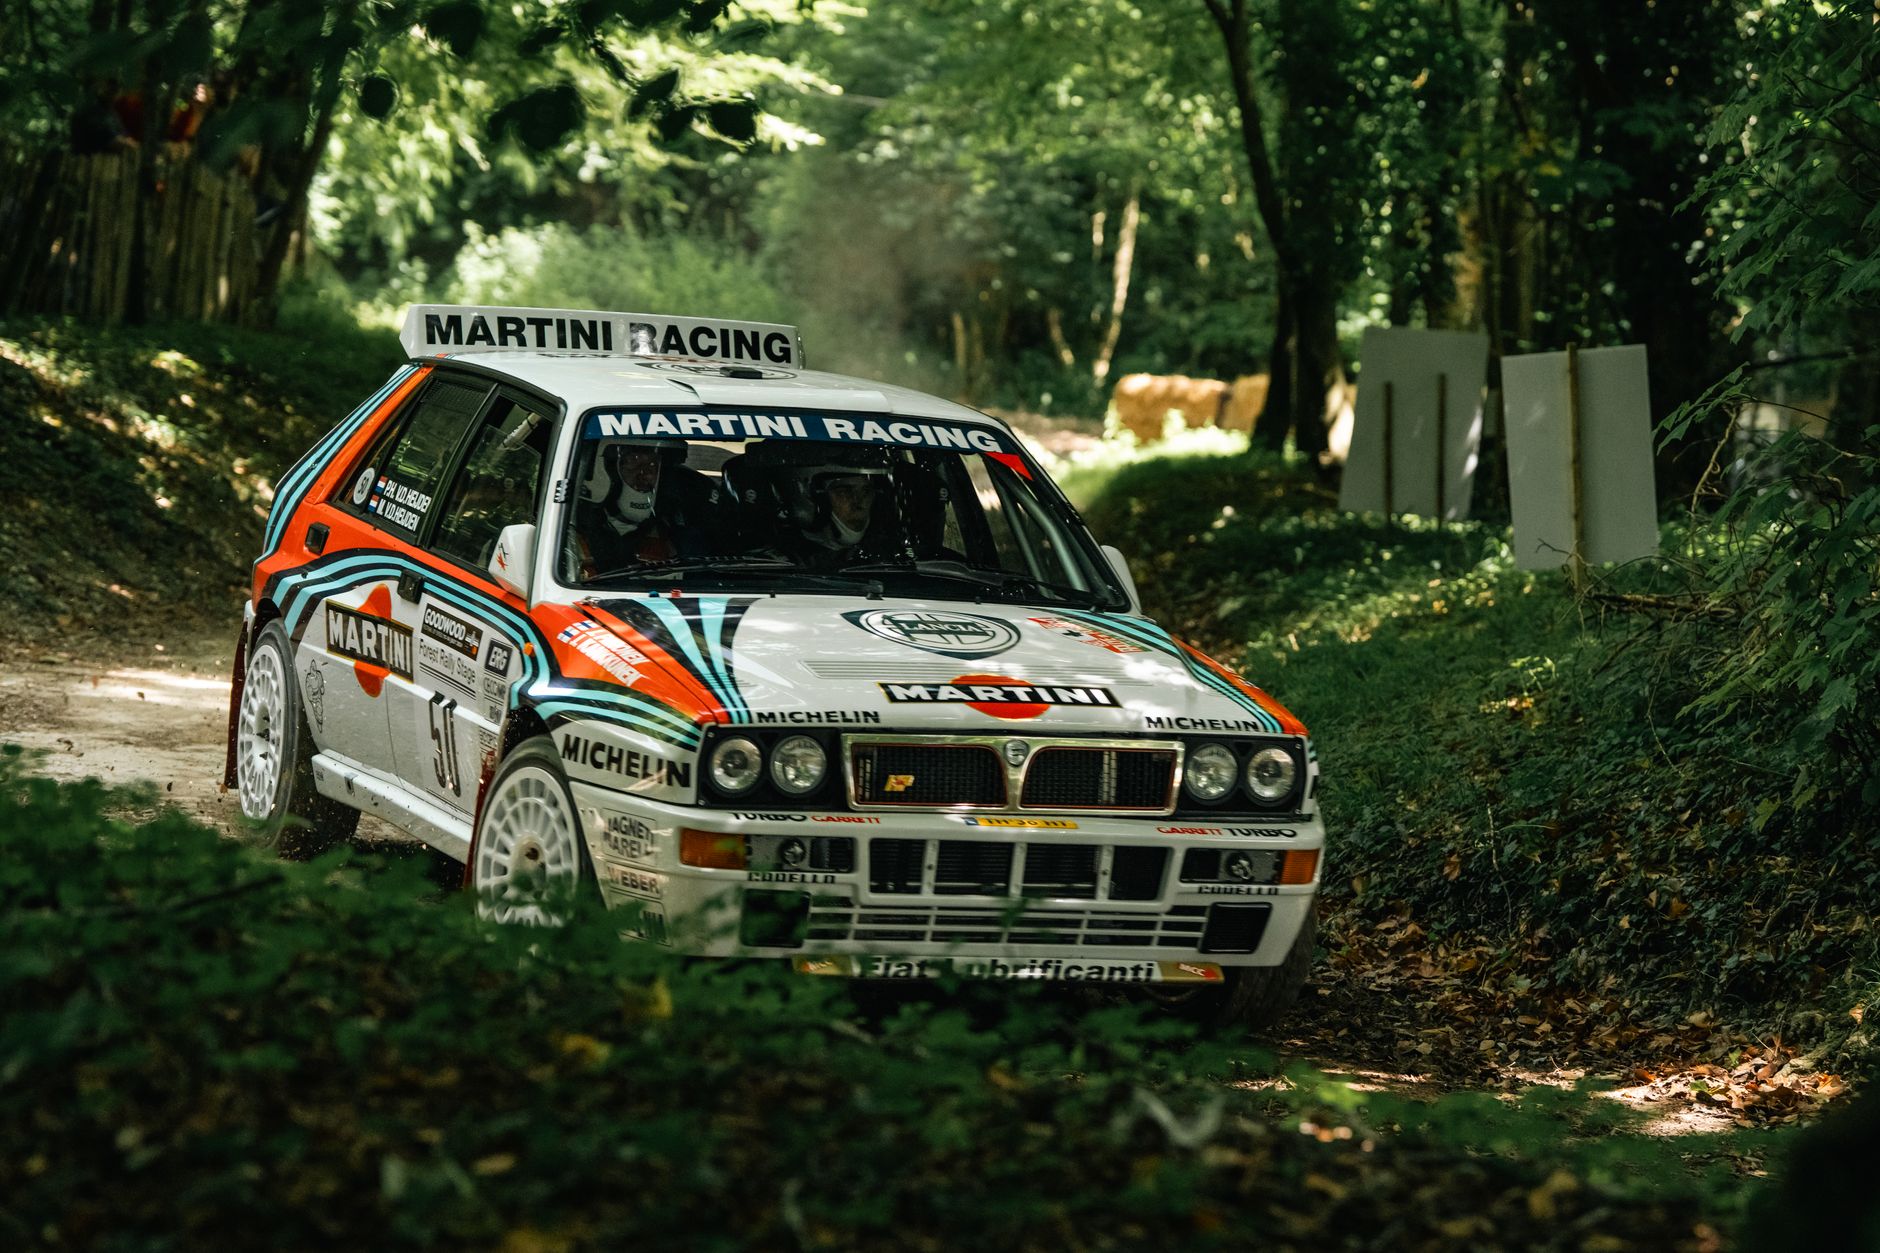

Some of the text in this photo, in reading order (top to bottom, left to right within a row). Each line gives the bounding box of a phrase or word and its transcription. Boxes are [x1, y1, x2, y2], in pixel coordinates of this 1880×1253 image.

[425, 313, 792, 364] MARTINI RACING
[598, 413, 1003, 453] MARTINI RACING
[424, 608, 466, 641] GOODWOOD
[900, 622, 982, 634] LANCIA
[328, 609, 412, 675] MARTINI
[419, 638, 476, 685] Forest Rally Stage
[488, 646, 509, 671] ERG
[889, 685, 1113, 705] MARTINI
[757, 710, 881, 724] MICHELIN
[1145, 716, 1260, 732] MICHELIN
[562, 733, 691, 788] MICHELIN
[728, 812, 881, 824] TURBO GARRETT
[1156, 826, 1298, 838] GARRETT TURBO
